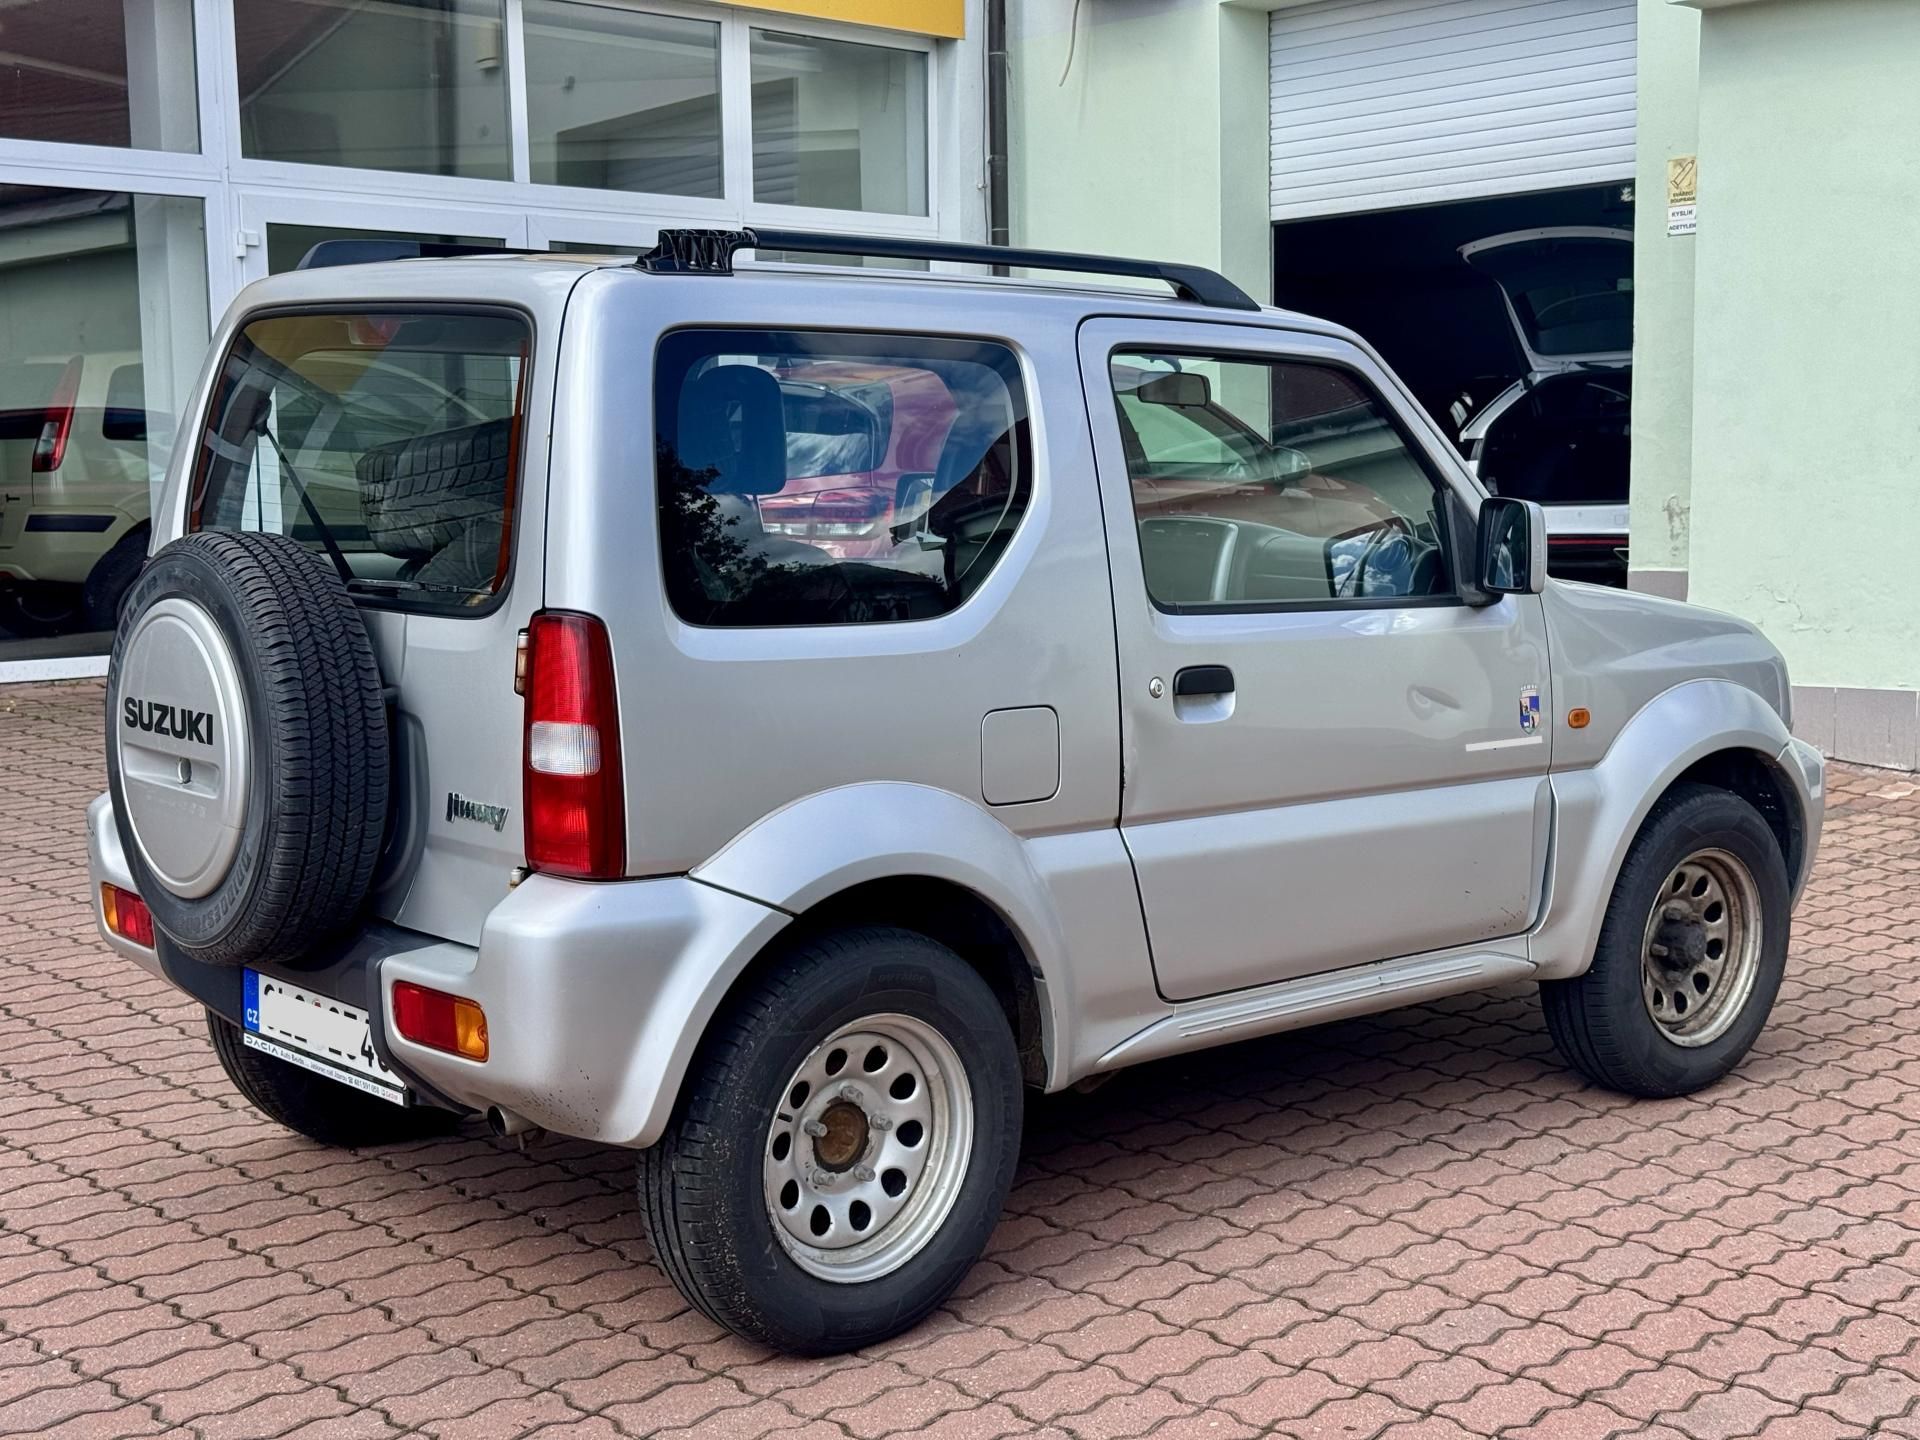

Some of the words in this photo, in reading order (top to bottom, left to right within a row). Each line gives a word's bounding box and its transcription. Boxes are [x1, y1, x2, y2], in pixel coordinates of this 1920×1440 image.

[124, 697, 213, 745] SUZUKI
[247, 1008, 258, 1023] CZ
[245, 1035, 278, 1055] DACIA
